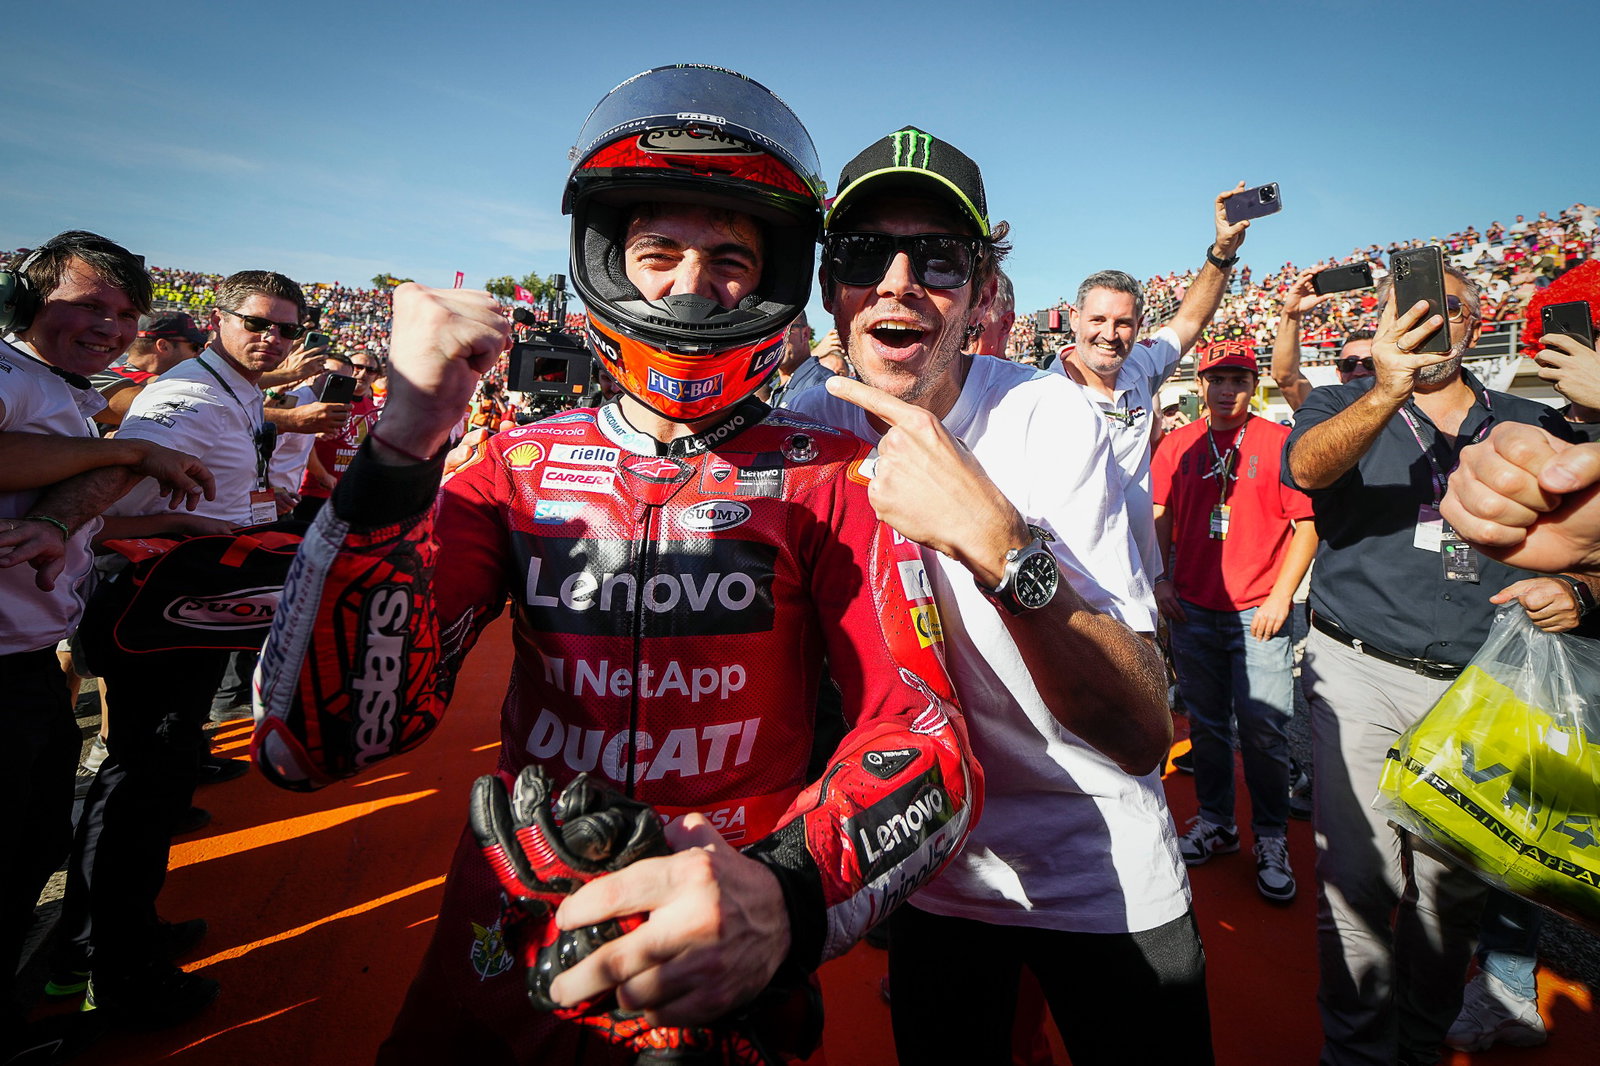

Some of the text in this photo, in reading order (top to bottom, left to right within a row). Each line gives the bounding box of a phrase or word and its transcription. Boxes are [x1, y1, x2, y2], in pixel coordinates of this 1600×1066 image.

[1207, 341, 1249, 365] 63
[650, 368, 721, 399] FLEX-BOX
[527, 427, 585, 436] motorola
[602, 405, 627, 436] BANCOMAT
[683, 415, 745, 454] Lenovo
[570, 448, 616, 462] riello
[545, 471, 612, 485] CARRERA
[740, 469, 779, 478] Lenovo
[687, 508, 745, 521] SUOMY
[525, 556, 756, 614] Lenovo
[185, 600, 276, 617] SUOM
[351, 588, 410, 768] nestars
[573, 659, 747, 703] NetApp
[525, 707, 761, 784] DUCATI
[859, 788, 943, 864] Lenovo
[1524, 846, 1600, 889] APPA
